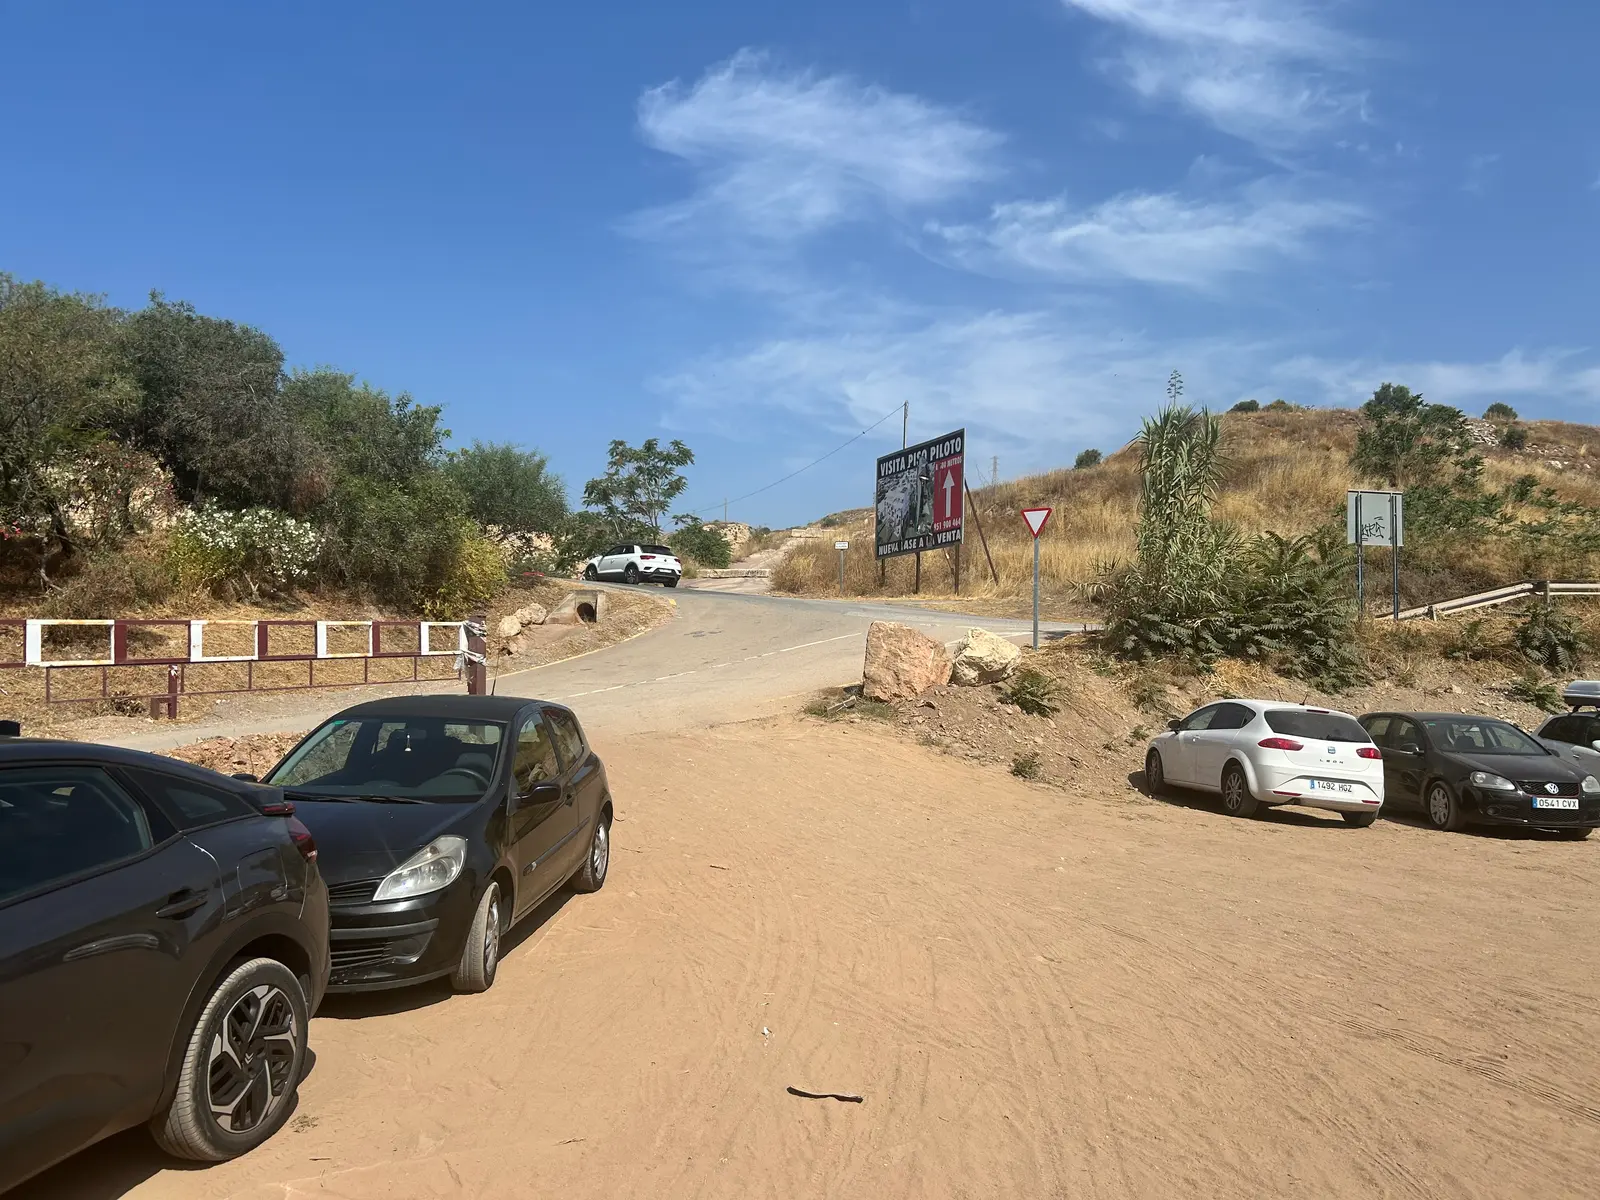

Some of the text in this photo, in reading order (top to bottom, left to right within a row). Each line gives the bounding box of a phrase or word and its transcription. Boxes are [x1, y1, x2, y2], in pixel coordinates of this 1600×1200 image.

[880, 437, 962, 476] VISITA PISO PILOTO
[878, 542, 898, 555] NUEVA
[919, 537, 924, 547] A
[937, 529, 961, 543] VENTA
[1317, 781, 1352, 793] 1492 HGZ
[1538, 799, 1577, 808] 0541 CVX
